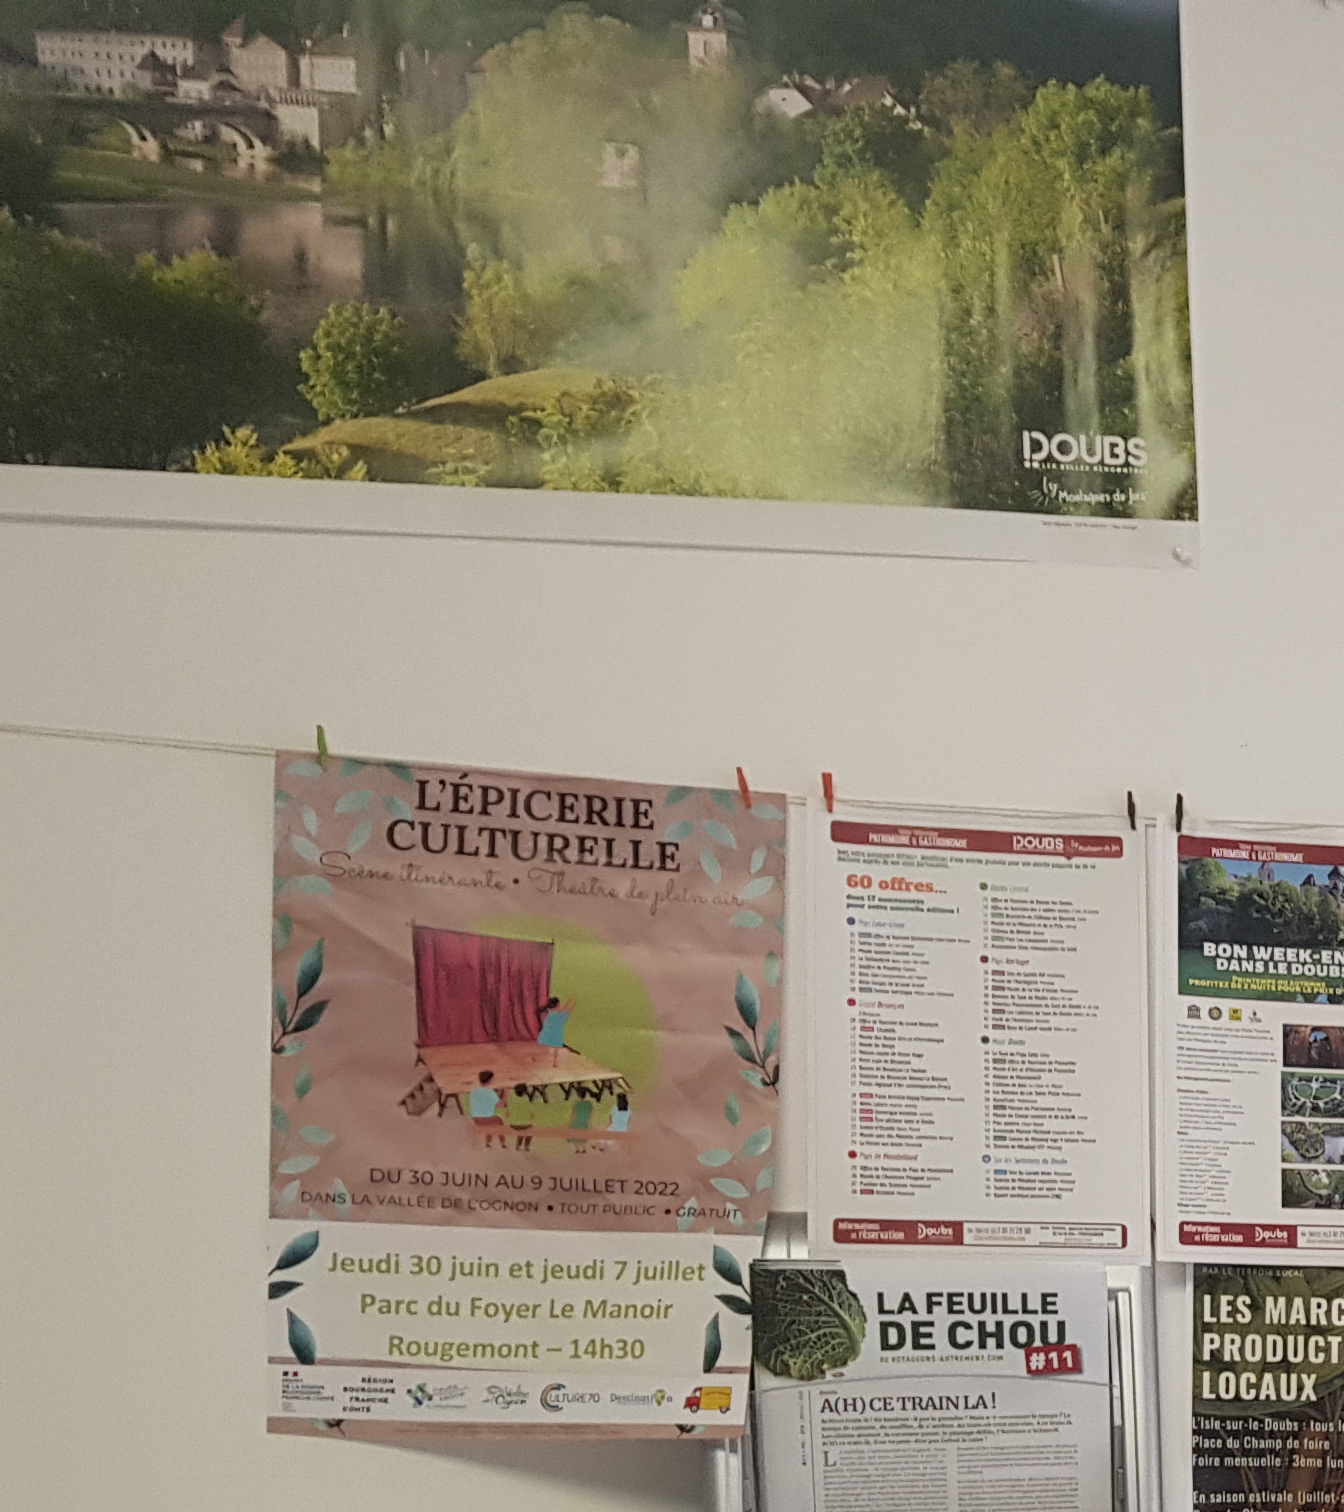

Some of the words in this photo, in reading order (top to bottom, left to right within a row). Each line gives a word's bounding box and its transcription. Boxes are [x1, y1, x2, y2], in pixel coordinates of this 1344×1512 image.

[1022, 430, 1148, 467] DOUBS
[415, 776, 654, 830] L'ÉPICERIE
[386, 818, 680, 872] CULTURELLE
[846, 874, 874, 890] 60
[1203, 942, 1246, 958] BON
[1216, 957, 1263, 974] DANS
[1267, 960, 1287, 976] LE
[369, 1167, 402, 1185] DU
[408, 1169, 434, 1186] 30
[439, 1170, 489, 1190] JUIN
[495, 1171, 524, 1190] AU
[530, 1174, 542, 1190] 9
[548, 1175, 628, 1196] JUILLET
[634, 1177, 680, 1197] 2022
[877, 1292, 916, 1315] LA
[926, 1292, 1059, 1315] FEUILLE
[1203, 1295, 1252, 1324] LES
[879, 1320, 935, 1350] DE
[947, 1320, 1066, 1350] CHOU
[388, 1335, 538, 1366] Rougemont
[569, 1337, 644, 1360] 14h30
[1027, 1349, 1074, 1370] #11
[1202, 1371, 1318, 1402] LOCAUX
